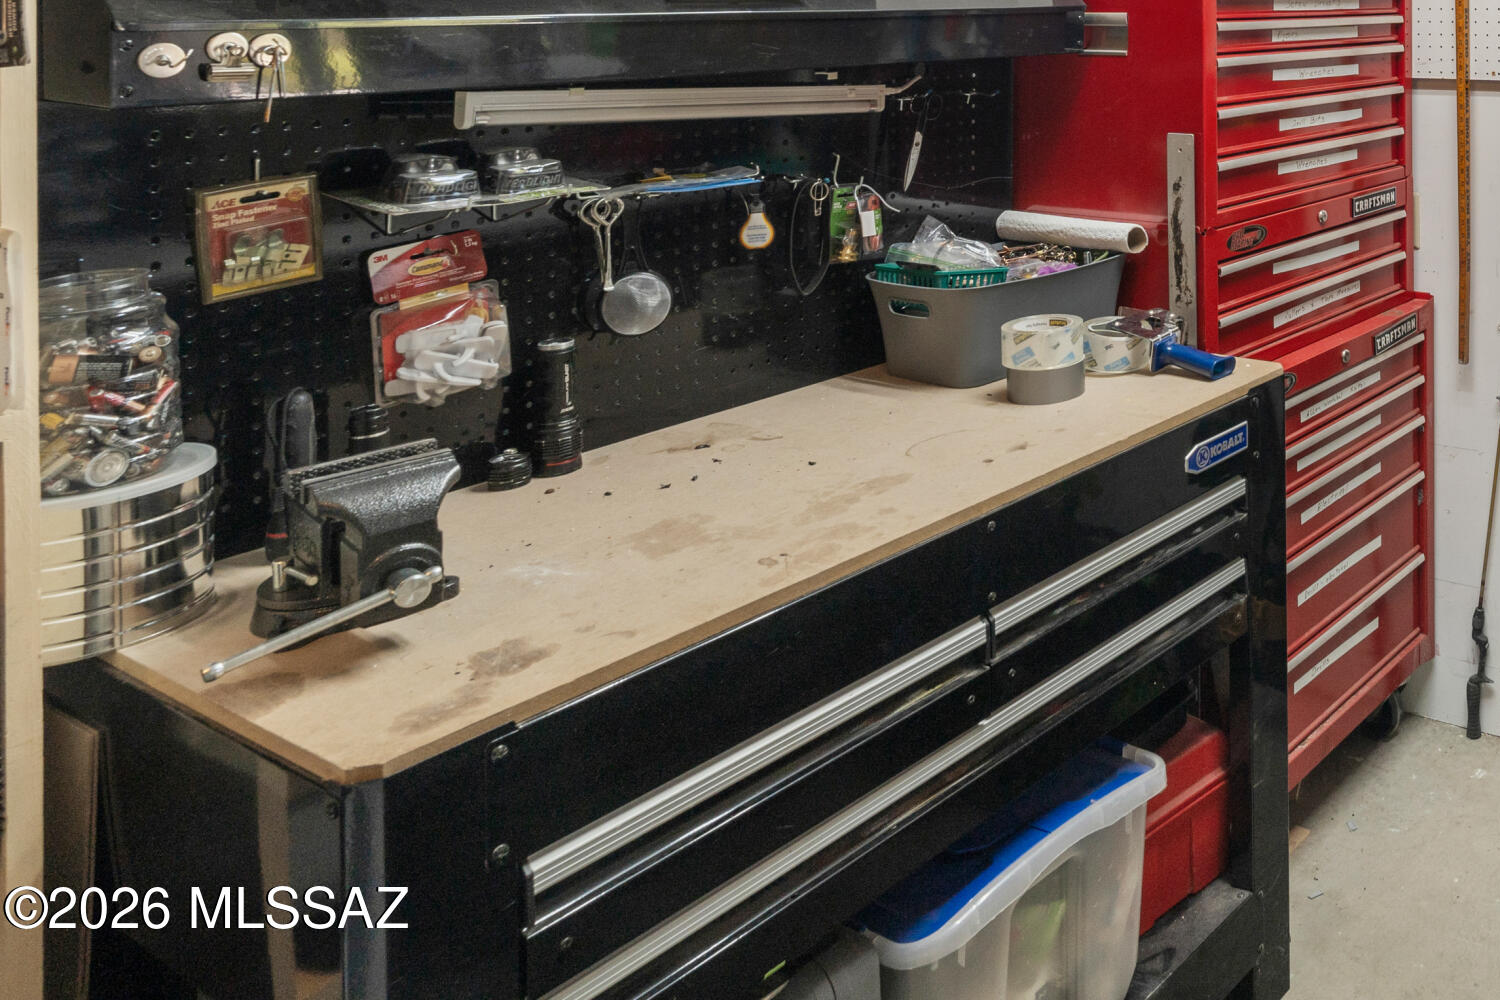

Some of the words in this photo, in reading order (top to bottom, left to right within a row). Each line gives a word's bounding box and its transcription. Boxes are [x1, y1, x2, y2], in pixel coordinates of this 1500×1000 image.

[211, 198, 236, 210] ACE
[1354, 191, 1396, 213] CRAFTSMAN
[212, 211, 236, 222] Snap
[373, 254, 388, 264] 3M
[412, 260, 443, 273] Command
[1376, 317, 1416, 350] CRAFTSMAN
[1210, 431, 1244, 458] KOBALT
